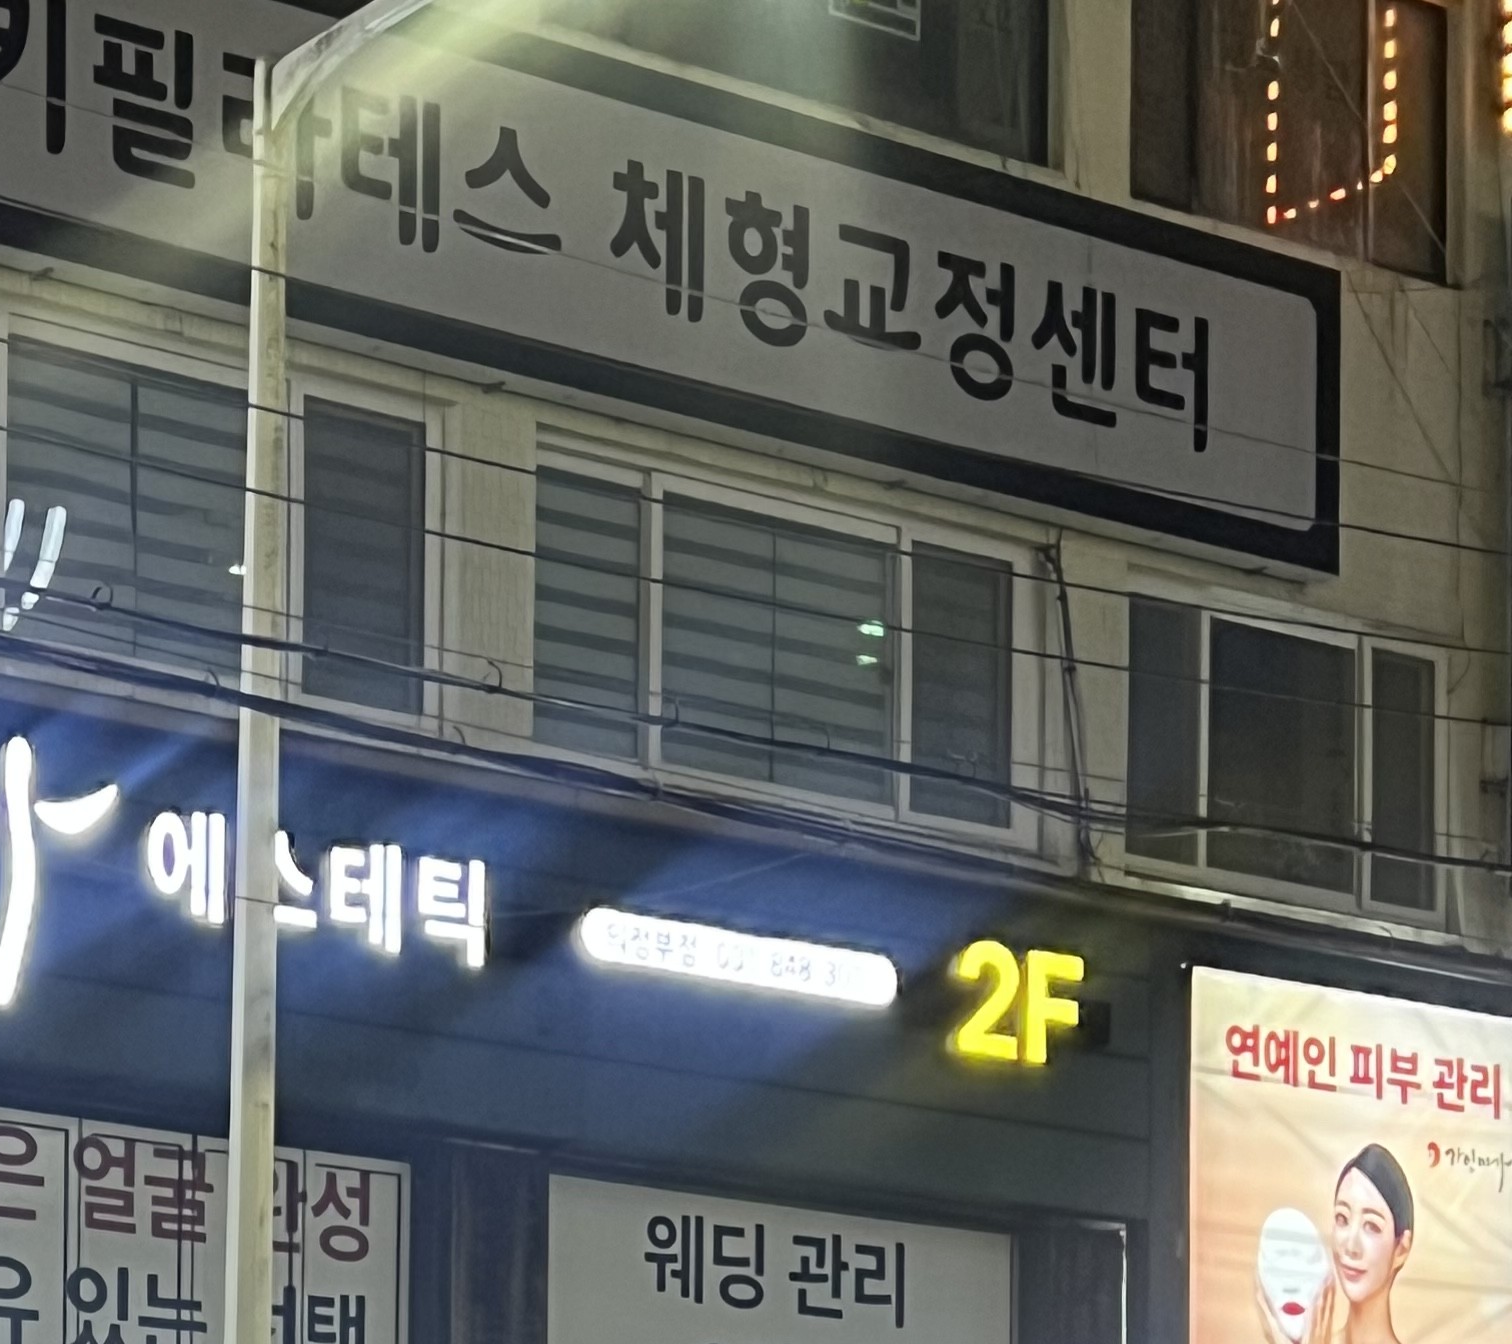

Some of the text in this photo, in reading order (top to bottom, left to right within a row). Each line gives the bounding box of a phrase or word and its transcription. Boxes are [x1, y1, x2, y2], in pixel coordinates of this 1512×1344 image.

[609, 157, 1213, 455] 체형교정센터
[951, 940, 1087, 1067] 2F
[1224, 1022, 1503, 1120] 연예인 피부 관리
[72, 1133, 215, 1244] 얼굴
[643, 1213, 906, 1330] 웨딩 관리
